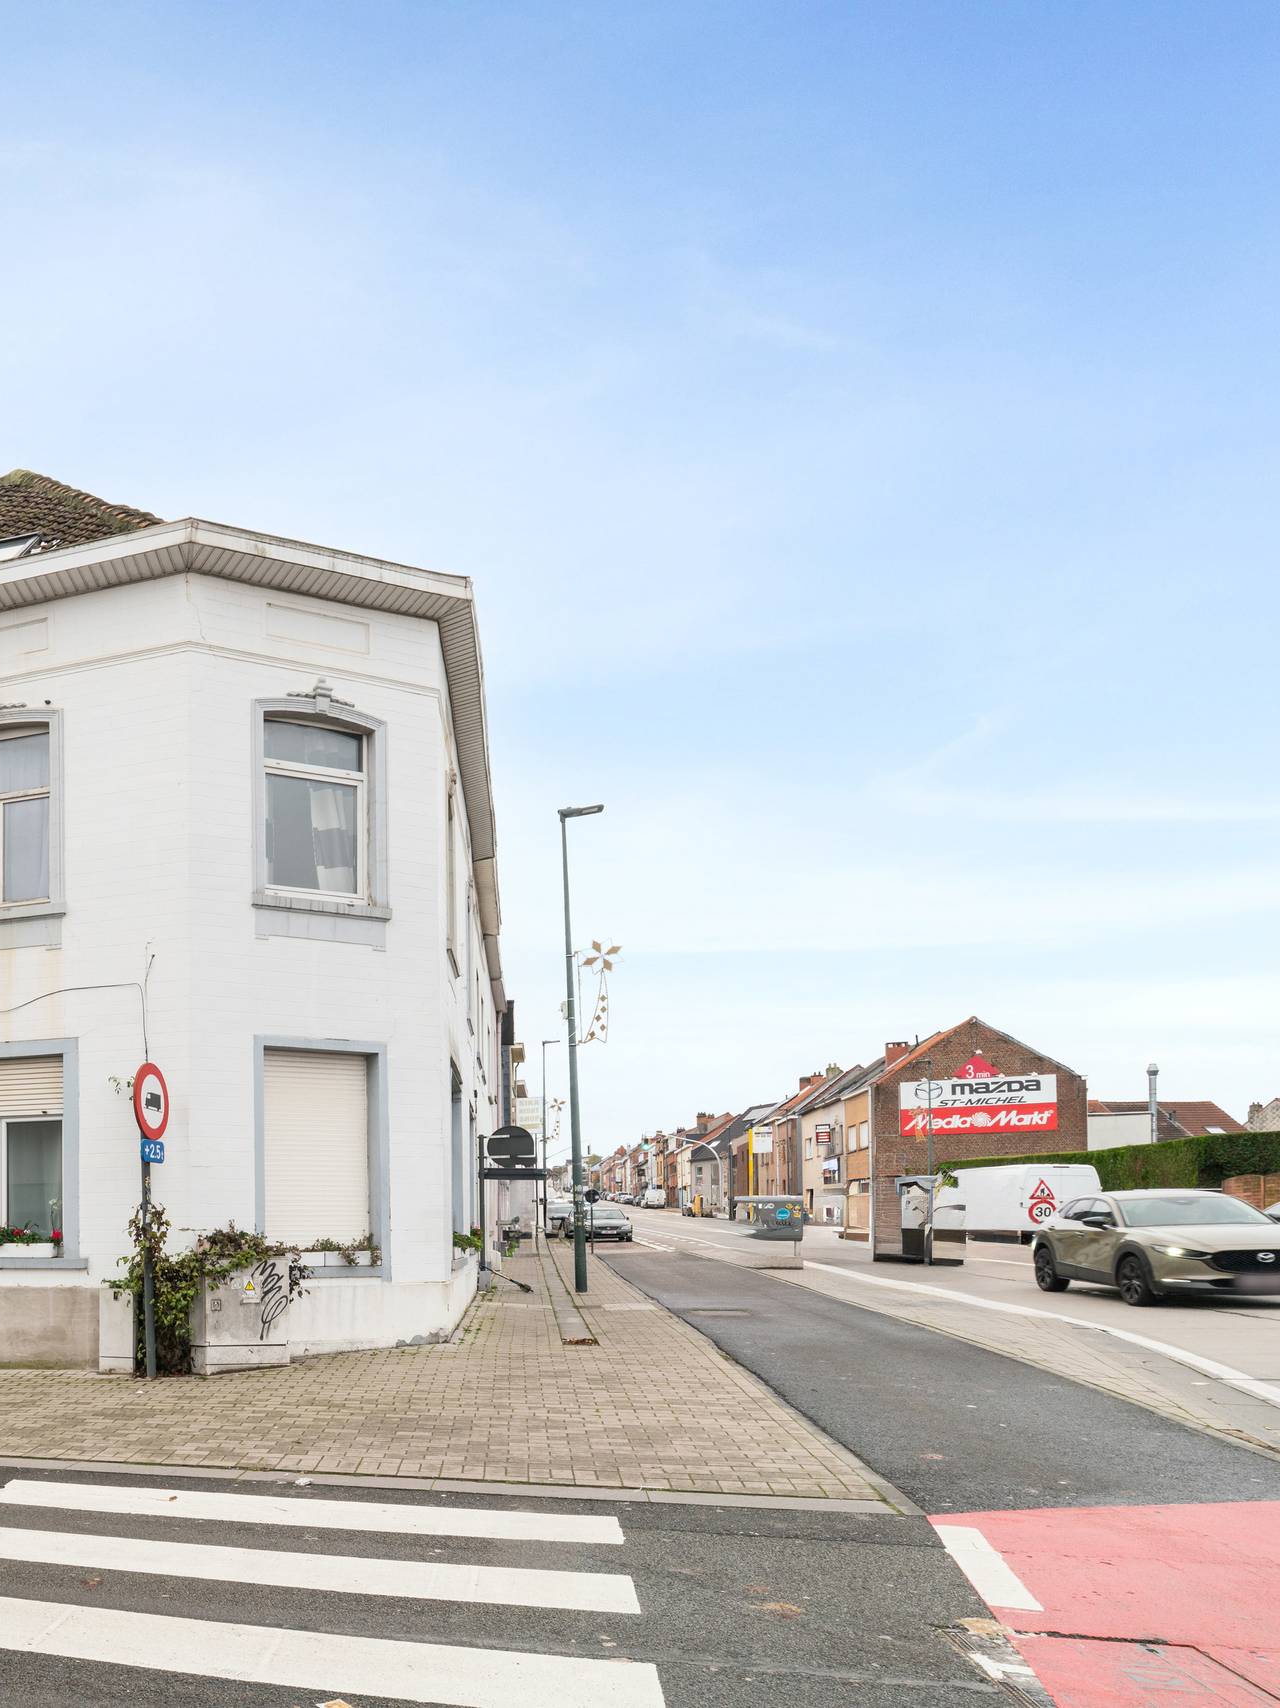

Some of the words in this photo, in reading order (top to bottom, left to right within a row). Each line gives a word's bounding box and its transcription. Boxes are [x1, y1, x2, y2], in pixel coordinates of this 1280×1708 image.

[965, 1064, 975, 1079] 3
[976, 1071, 991, 1079] min
[938, 1096, 1027, 1107] ST-MICHEL
[1035, 1206, 1051, 1217] 30
